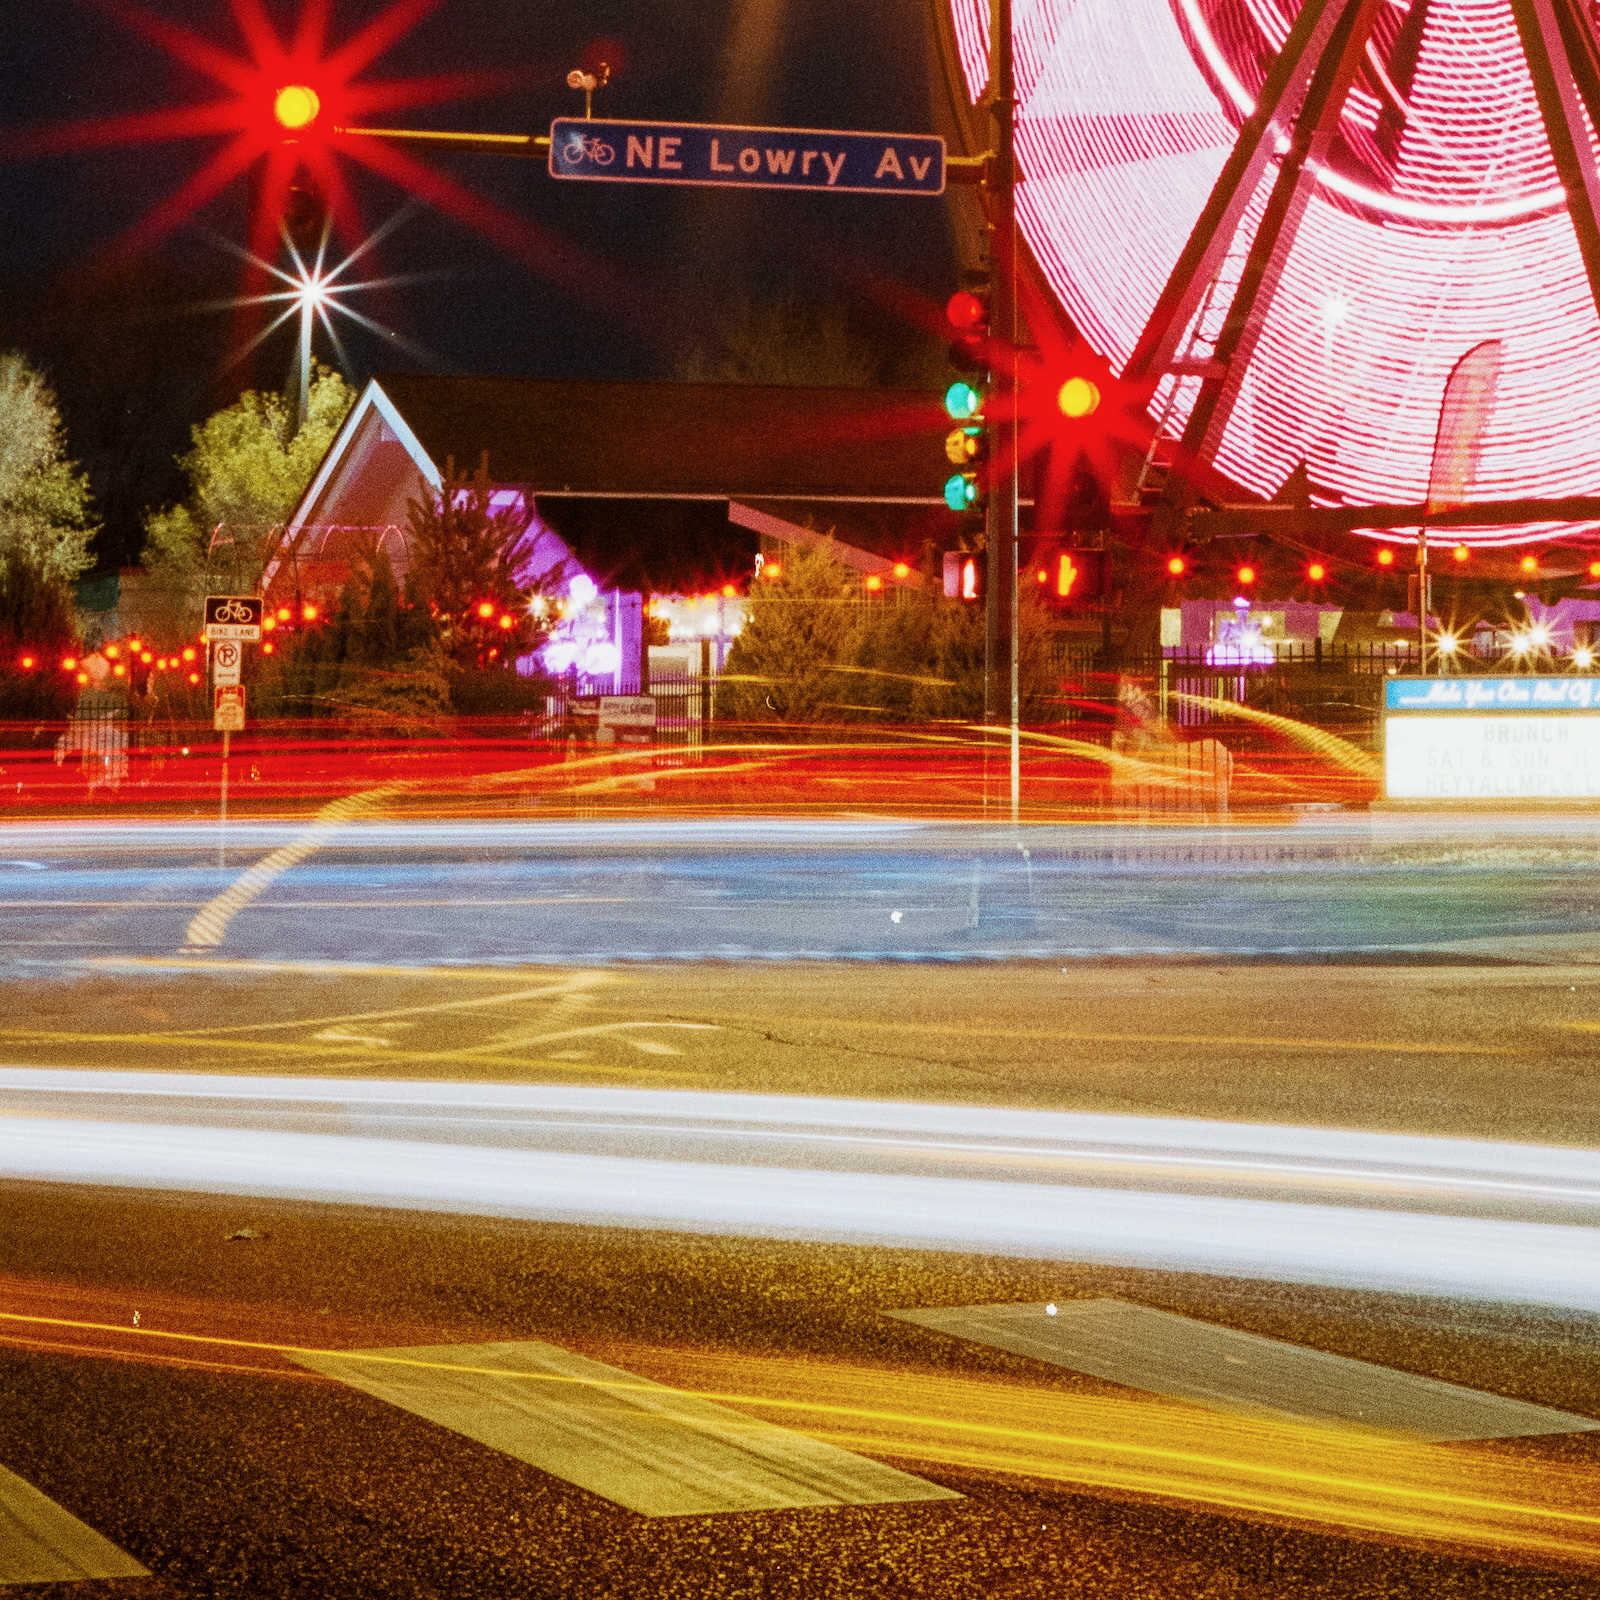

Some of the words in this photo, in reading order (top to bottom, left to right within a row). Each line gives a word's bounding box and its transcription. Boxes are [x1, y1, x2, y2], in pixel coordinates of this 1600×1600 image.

[626, 135, 683, 170] NE
[709, 139, 847, 185] Lowry
[874, 146, 932, 181] Av
[211, 625, 230, 636] BIKE
[236, 626, 256, 638] LANE
[1483, 723, 1569, 743] BRUNCH
[1426, 748, 1467, 768] SAT
[1480, 748, 1493, 768] &
[1509, 748, 1550, 768] SUN
